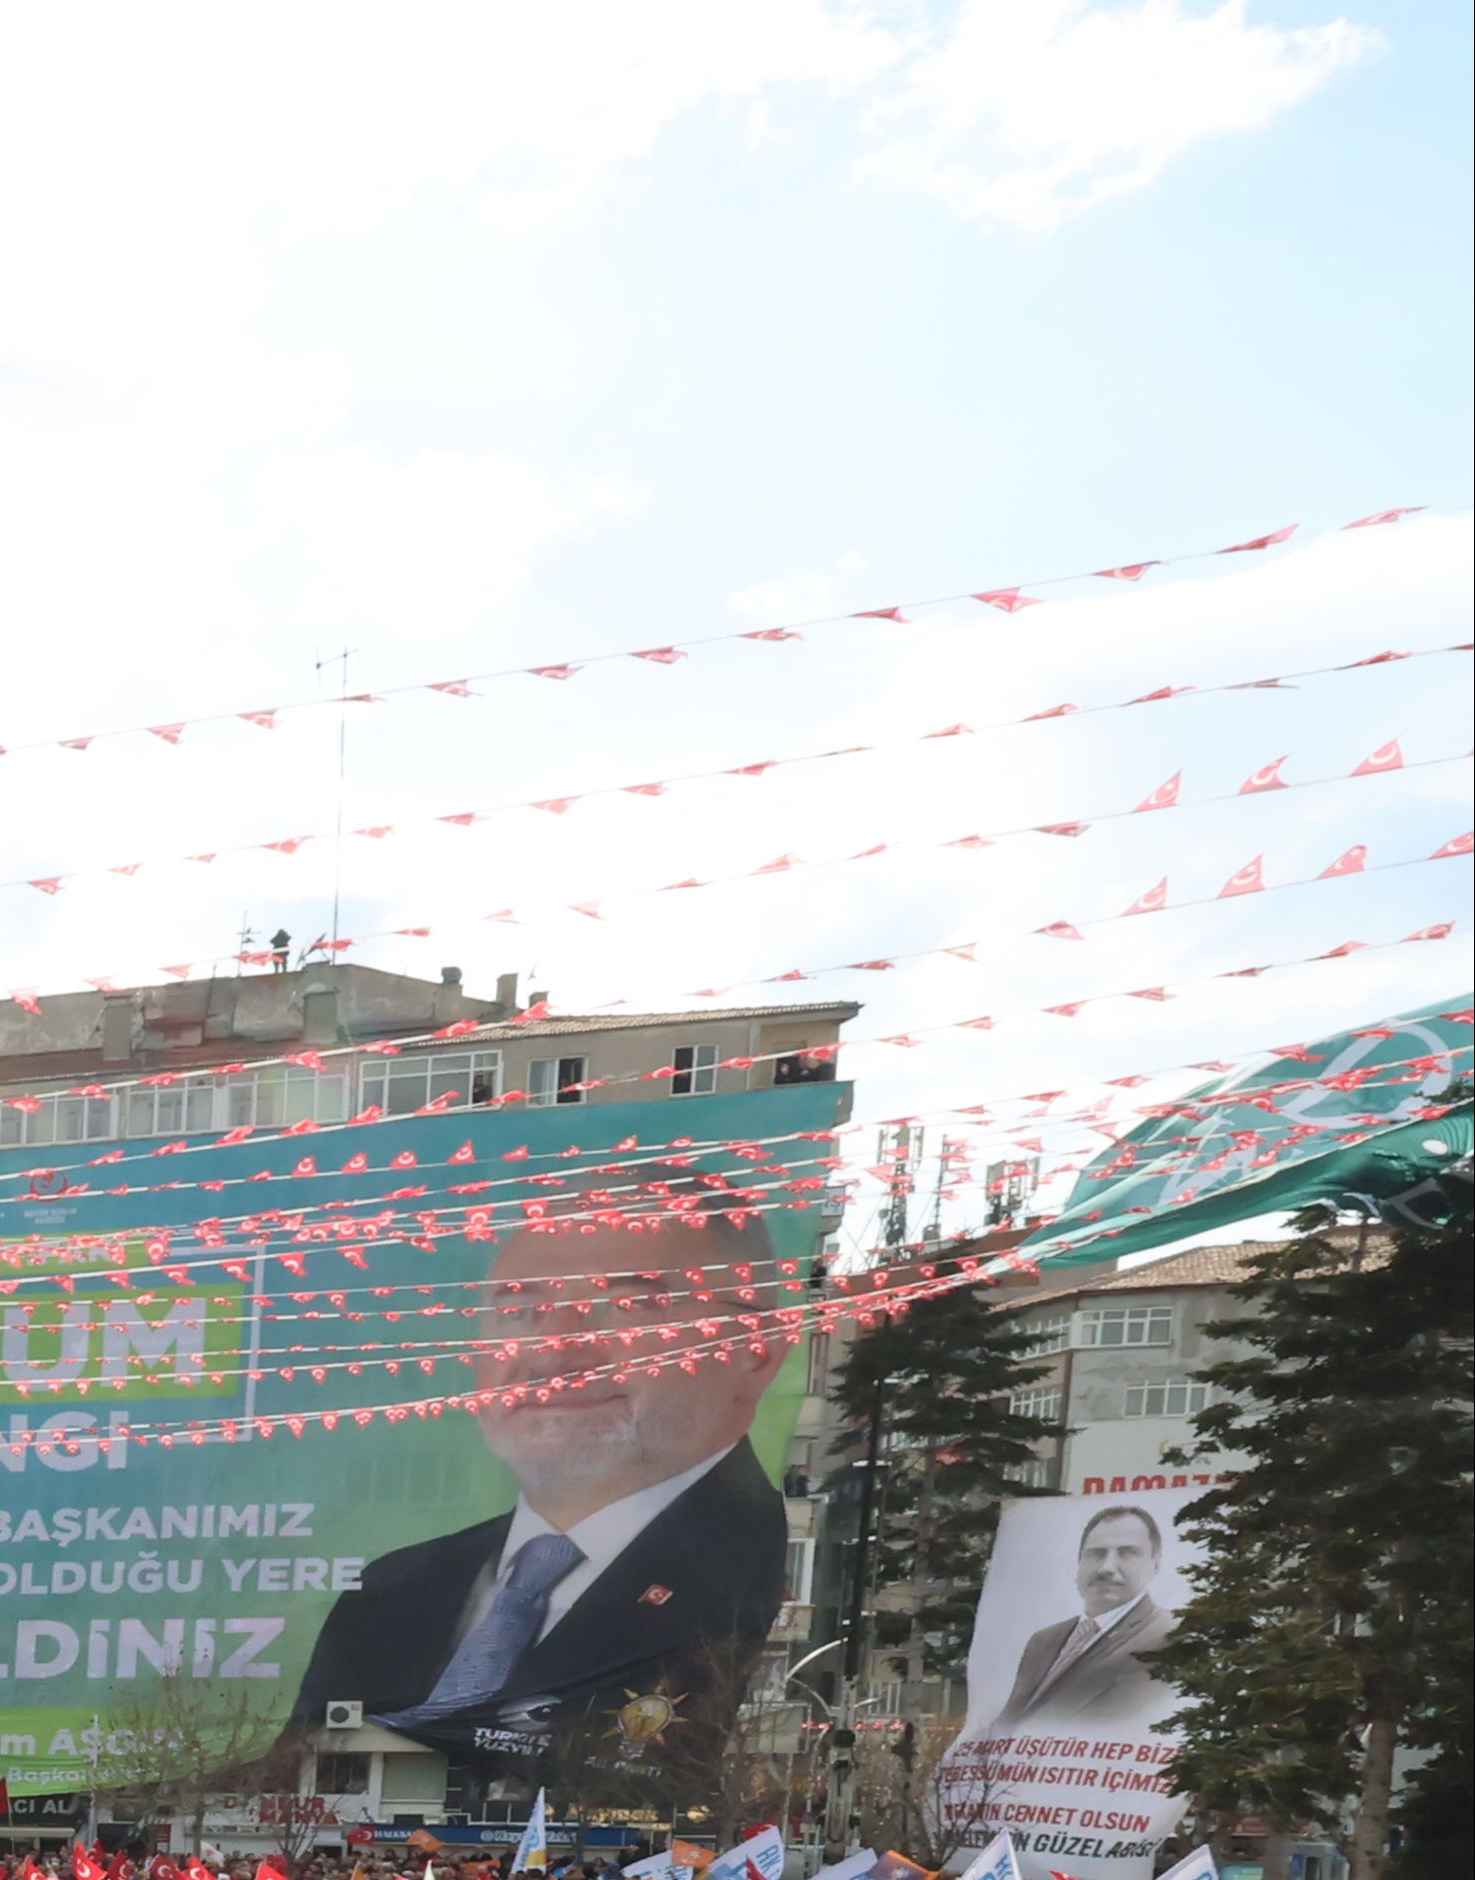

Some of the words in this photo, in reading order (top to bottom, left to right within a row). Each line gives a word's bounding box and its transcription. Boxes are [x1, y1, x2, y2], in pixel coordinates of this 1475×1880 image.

[221, 1556, 365, 1592] YERE
[47, 1726, 184, 1764] AŞG
[1016, 1735, 1087, 1759] ÜŞÜTÜR
[1090, 1742, 1133, 1760] HEP
[1003, 1803, 1078, 1827] CENNET
[1079, 1810, 1151, 1833] OLSUN
[1034, 1830, 1104, 1859] GÜZEL
